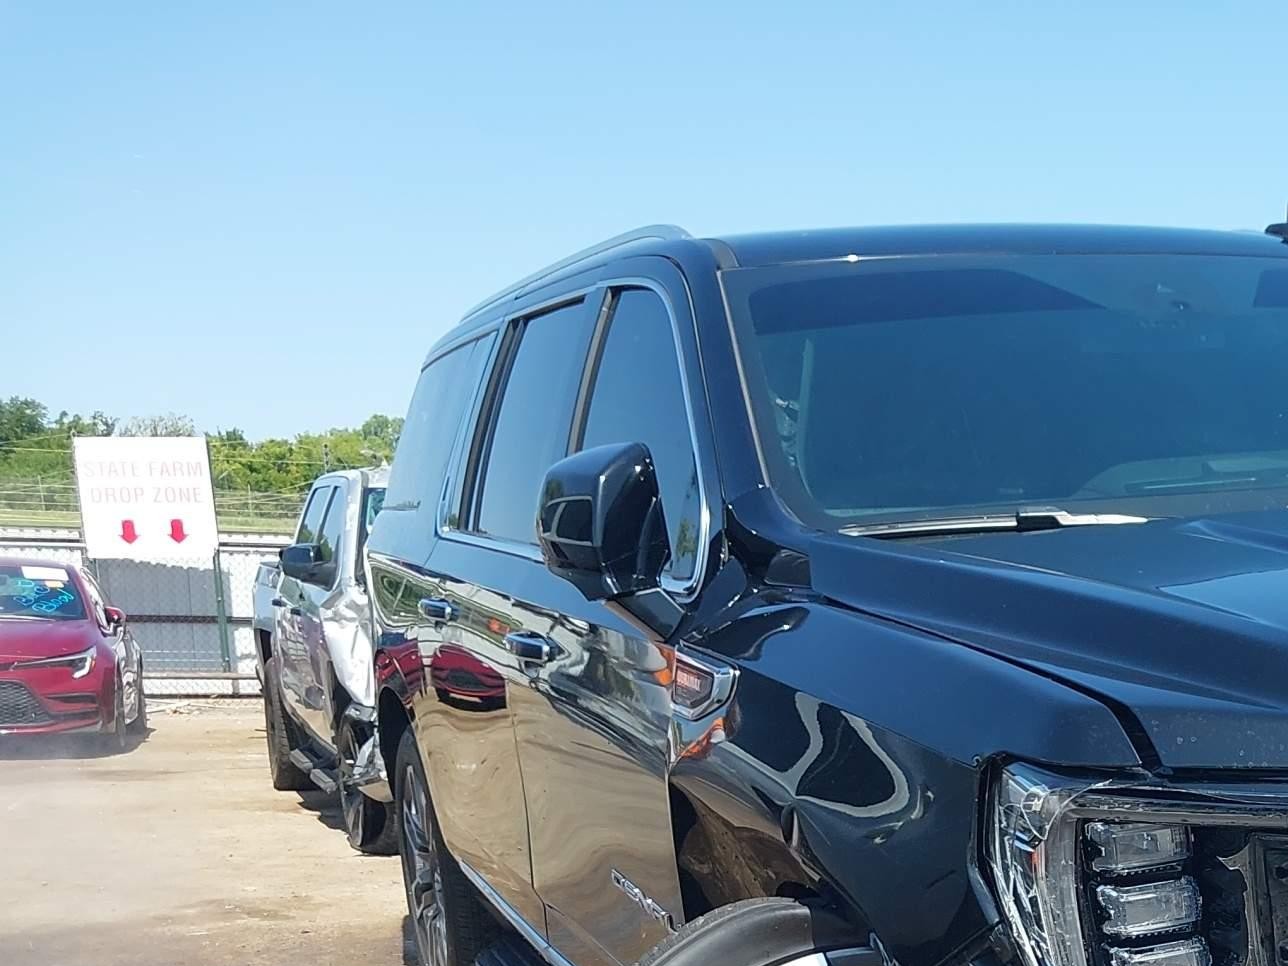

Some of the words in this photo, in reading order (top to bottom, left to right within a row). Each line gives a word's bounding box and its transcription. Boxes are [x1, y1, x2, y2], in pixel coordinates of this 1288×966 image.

[83, 460, 141, 478] STATE
[148, 460, 203, 477] FARM
[90, 486, 145, 503] DROP
[153, 486, 204, 503] ZONE
[611, 868, 680, 936] DENAL
